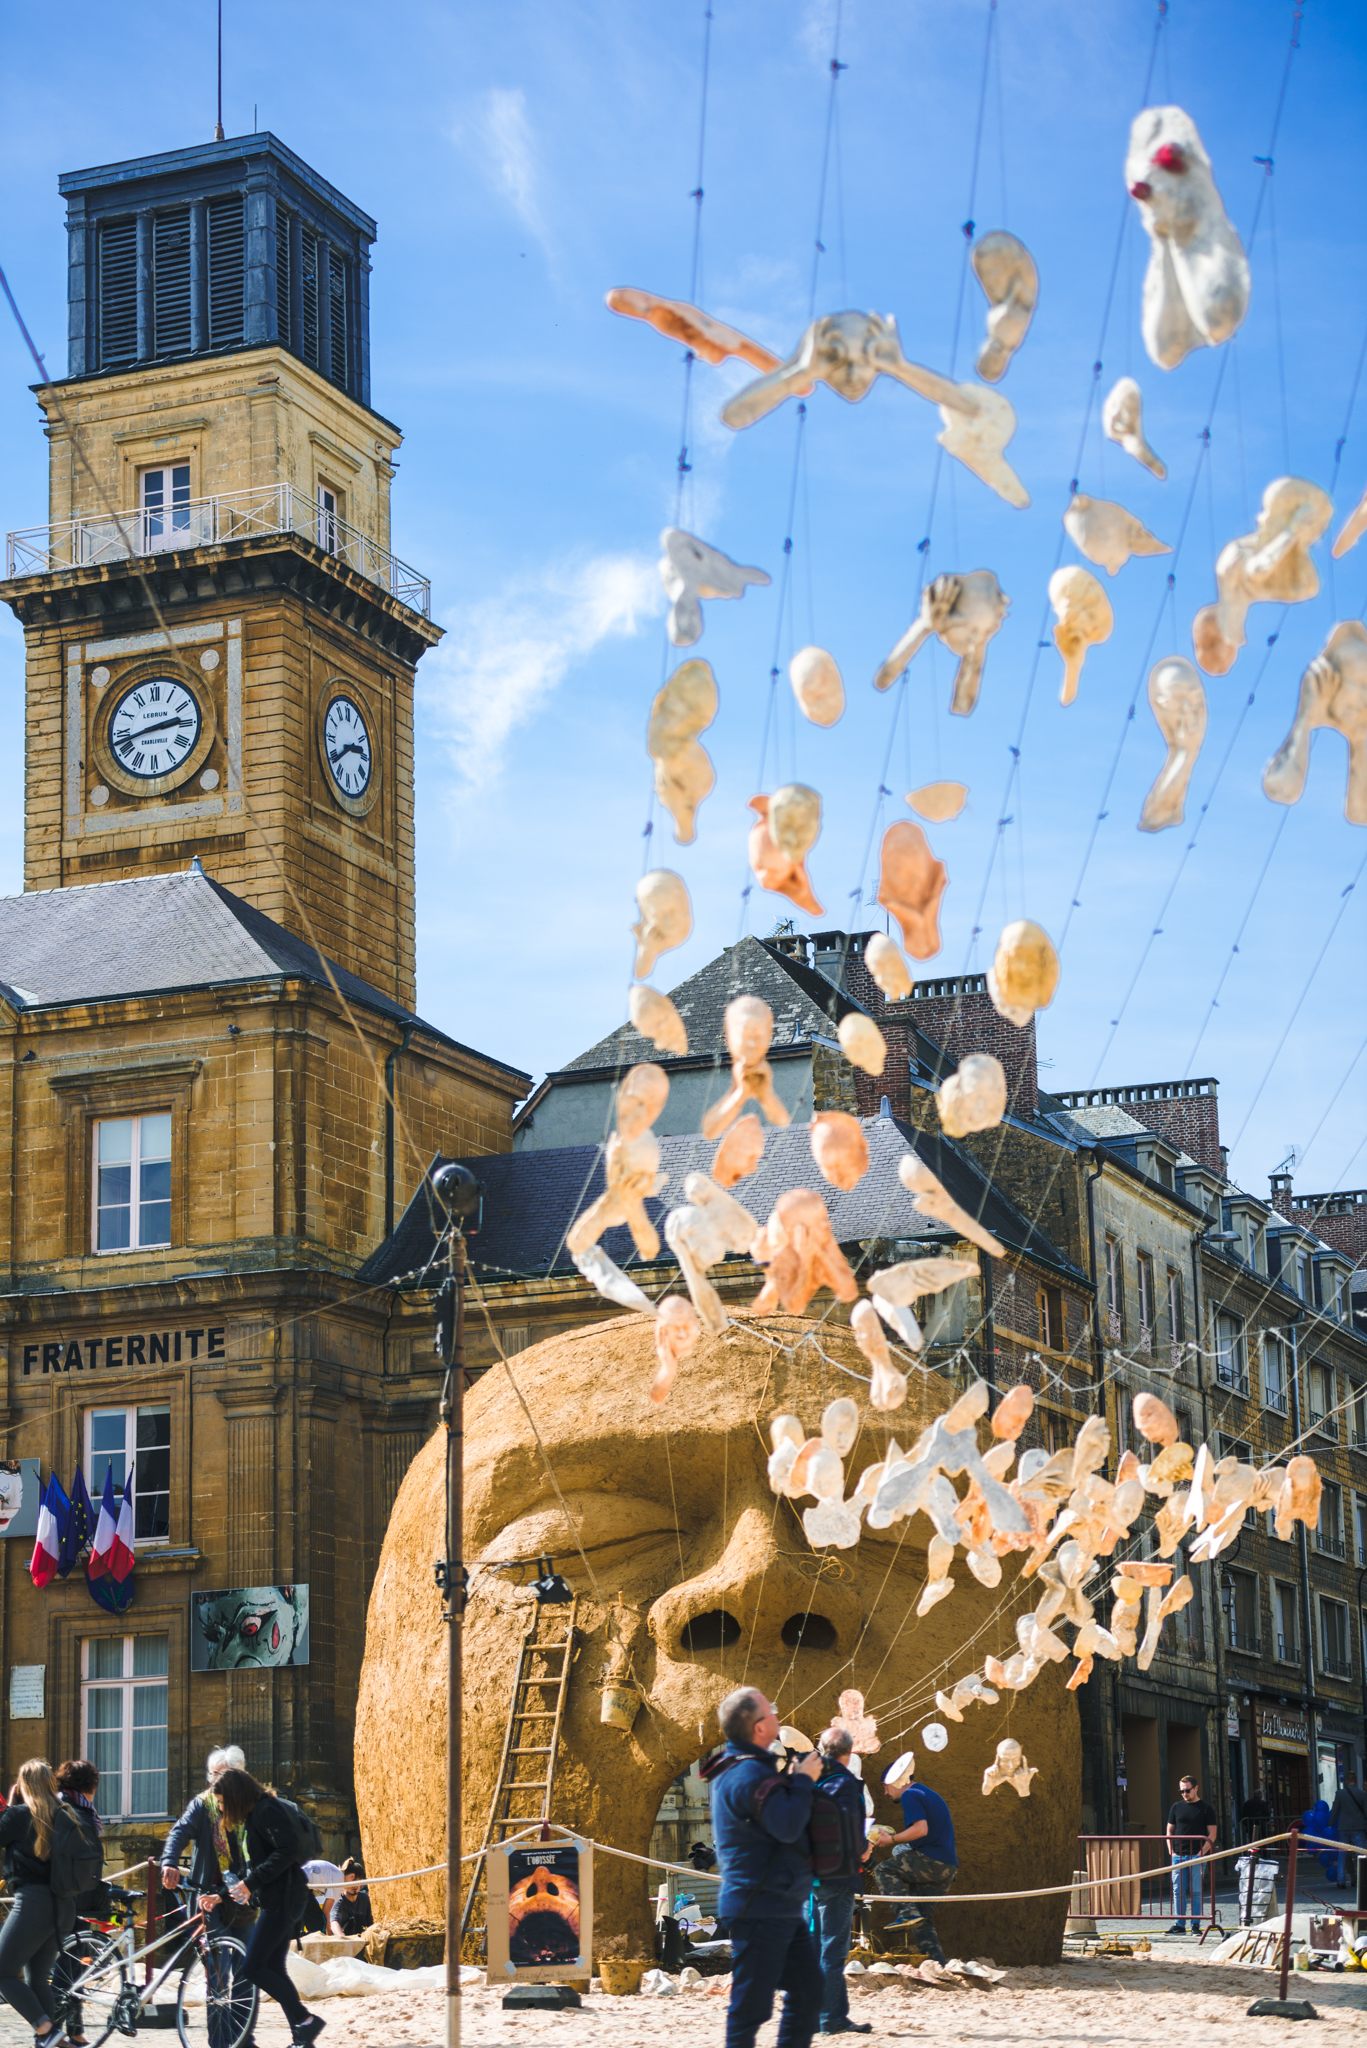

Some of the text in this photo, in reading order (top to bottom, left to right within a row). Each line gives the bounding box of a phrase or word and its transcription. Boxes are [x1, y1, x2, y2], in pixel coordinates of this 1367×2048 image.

[134, 694, 146, 709] XI
[150, 686, 160, 702] XII
[175, 700, 189, 713] II
[23, 1327, 226, 1376] FRATERNITE
